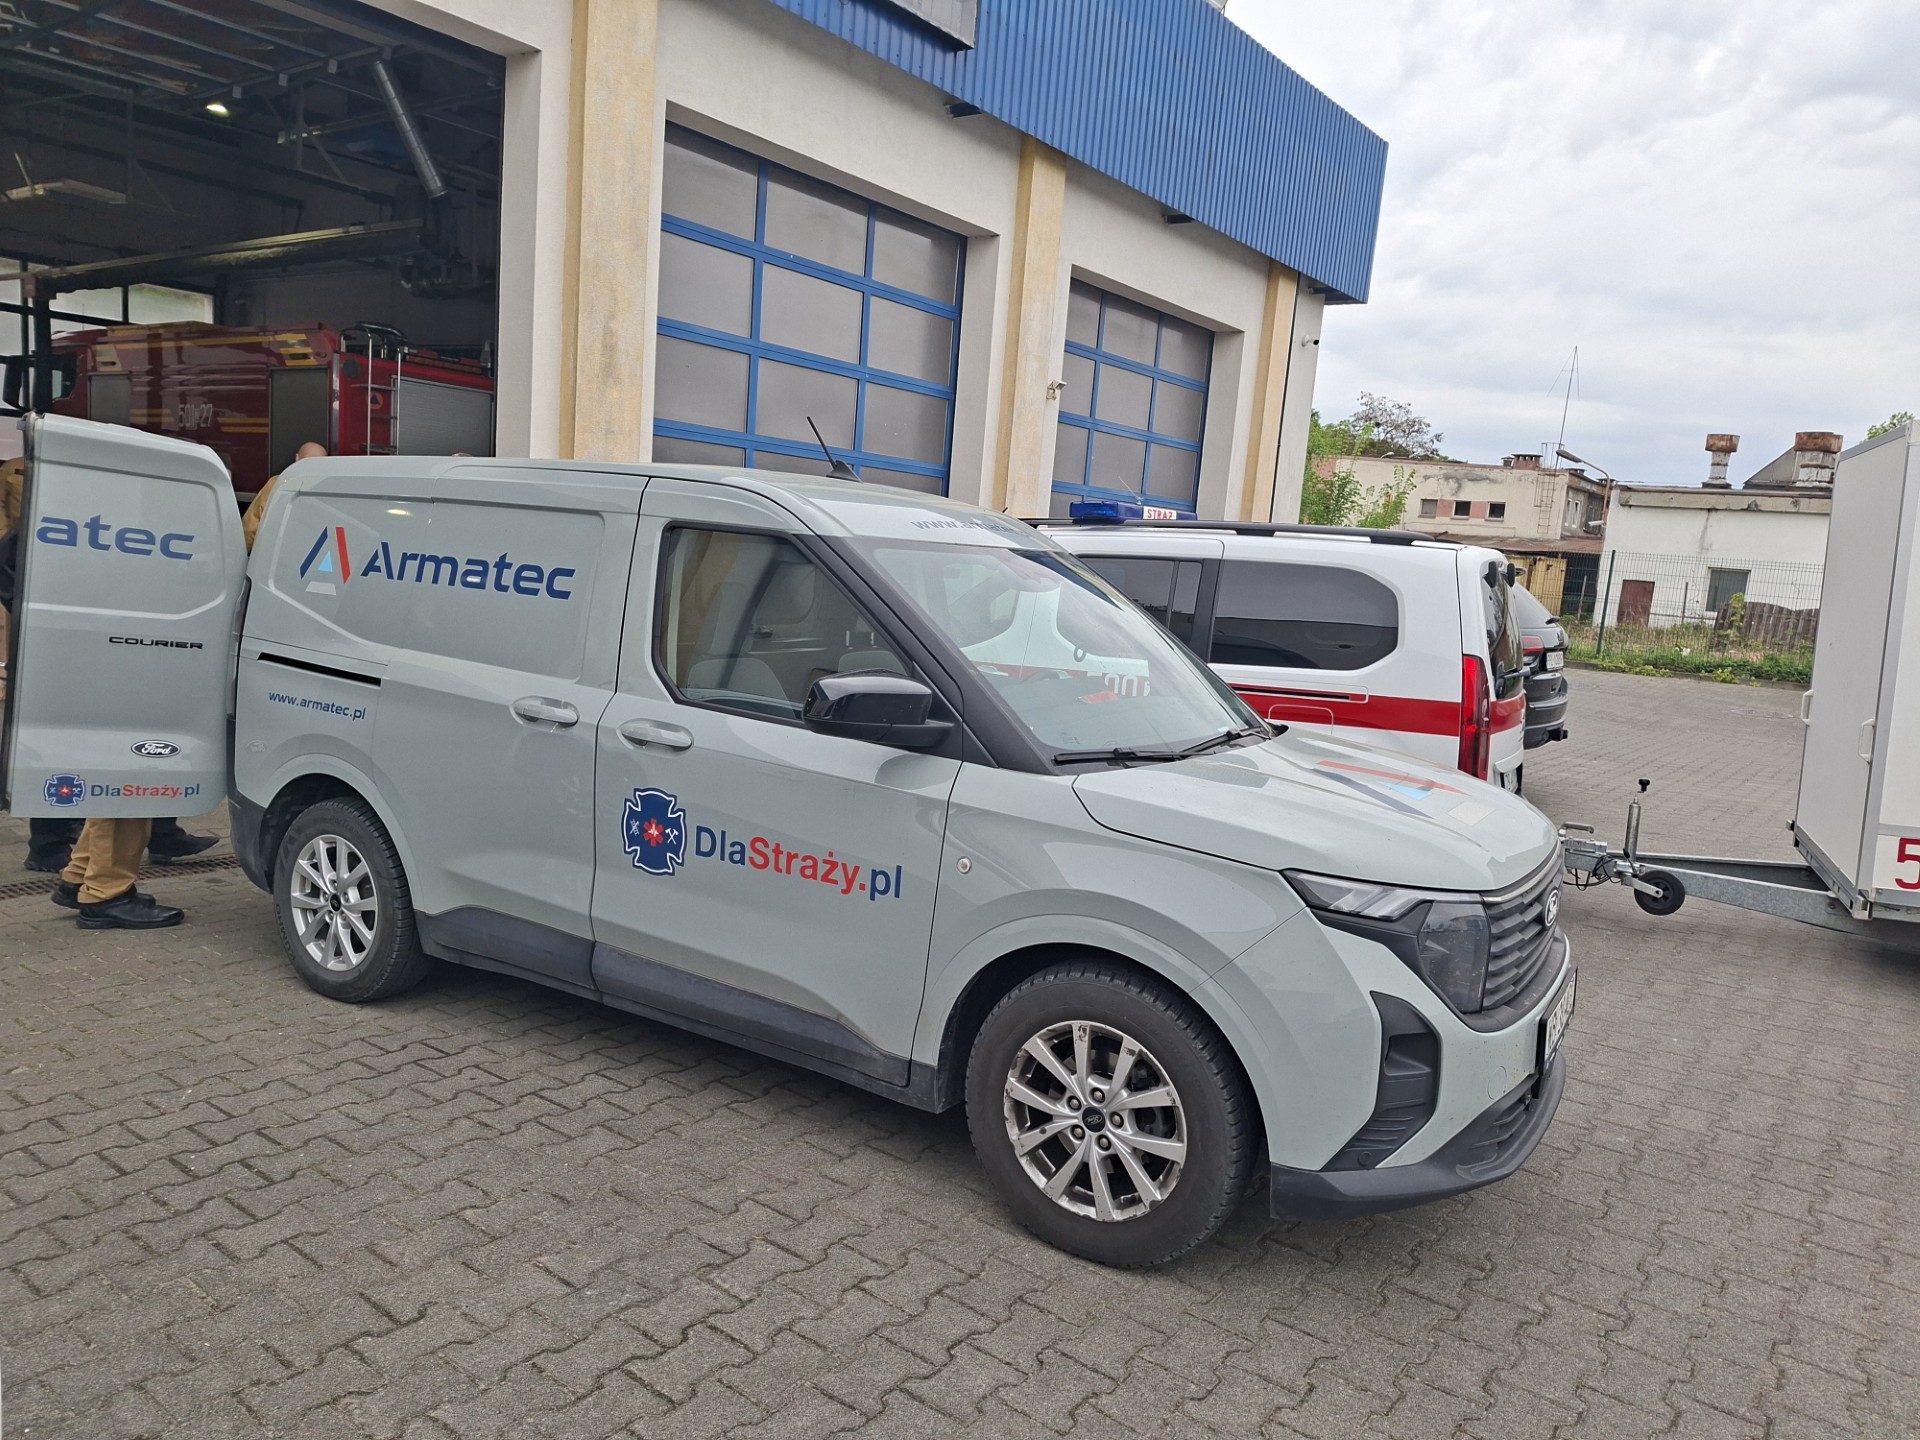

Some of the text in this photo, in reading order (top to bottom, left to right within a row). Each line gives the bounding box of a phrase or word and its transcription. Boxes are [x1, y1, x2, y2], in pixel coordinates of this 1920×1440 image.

[360, 541, 576, 600] Armatec
[108, 635, 204, 650] COURIER
[268, 691, 366, 721] www.armatec.pl
[90, 783, 200, 799] DlaStraży.pl
[695, 824, 902, 901] DlaStraży.pl
